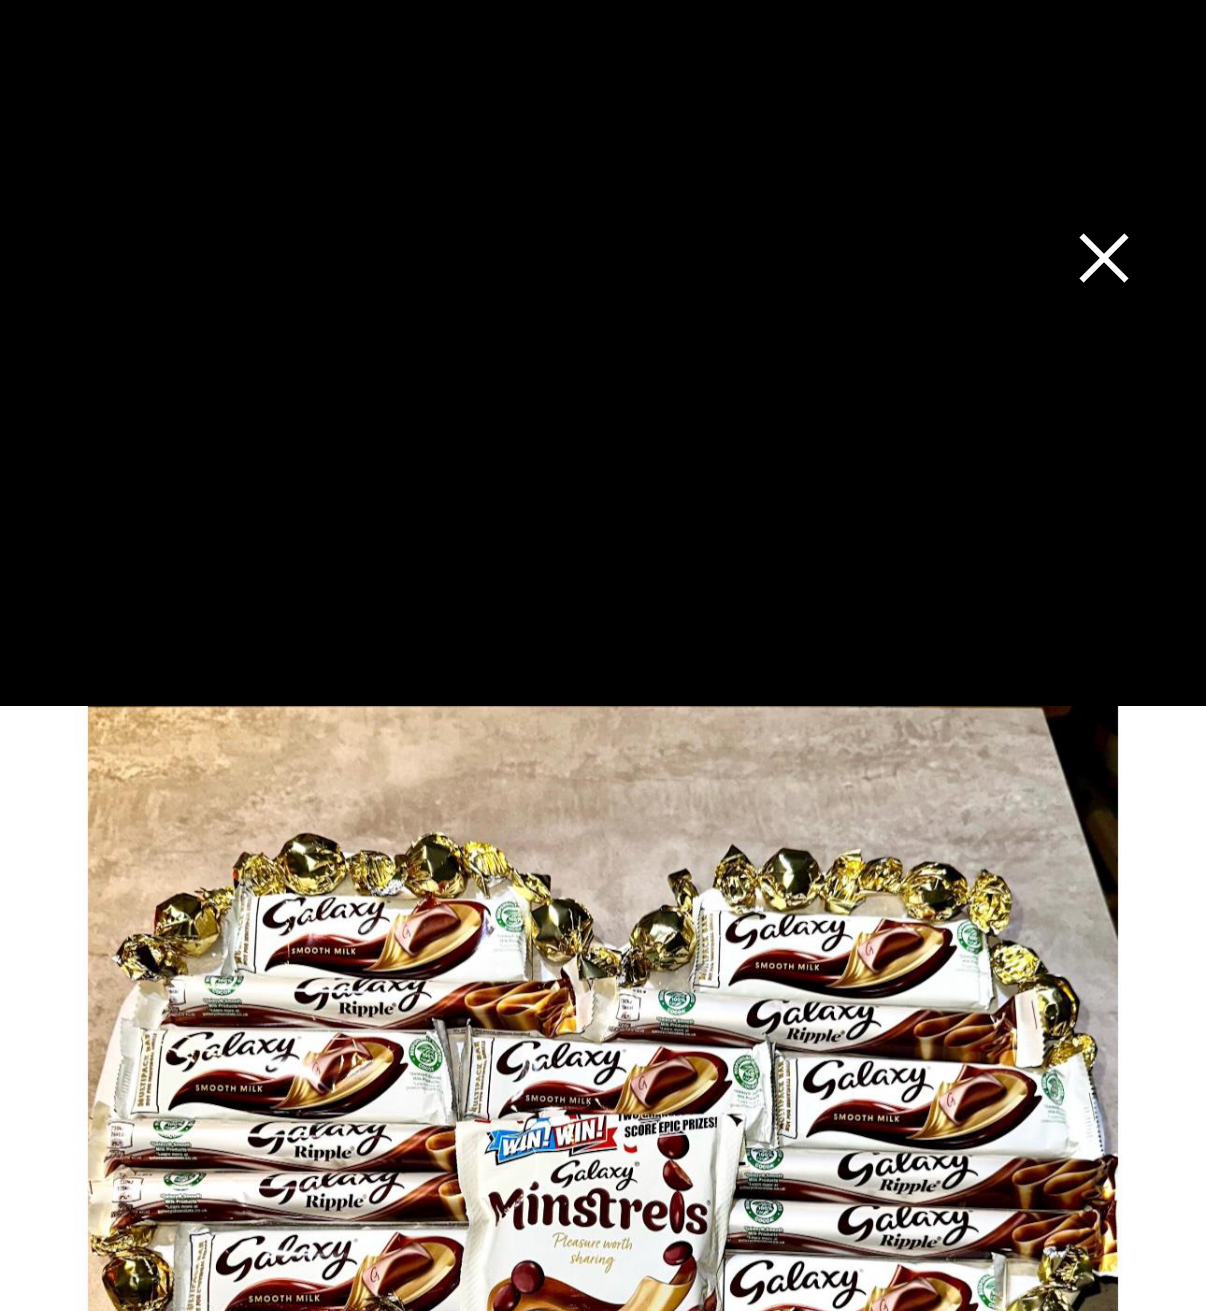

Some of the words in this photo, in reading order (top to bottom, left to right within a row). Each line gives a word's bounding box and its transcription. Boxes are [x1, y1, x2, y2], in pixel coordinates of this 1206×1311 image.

[262, 897, 390, 936] Galaxy
[725, 911, 854, 952] Galaxy
[291, 946, 331, 956] SMOOTH
[333, 947, 357, 956] MILK
[754, 961, 795, 972] SMOOTH
[797, 962, 820, 972] MILK
[339, 1002, 394, 1018] Ripple
[746, 999, 882, 1041] Galaxy
[786, 1027, 841, 1045] Ripple
[165, 1031, 300, 1073] Galaxy
[496, 1040, 627, 1085] Galaxy
[195, 1084, 237, 1093] SMOOTH
[239, 1085, 263, 1094] MILK
[803, 1060, 935, 1103] Galaxy
[525, 1094, 566, 1104] SMOOTH
[568, 1096, 592, 1106] MILK
[624, 1123, 657, 1138] SCORE
[658, 1119, 681, 1133] EPIC
[682, 1116, 718, 1131] PRIZES!
[833, 1112, 875, 1123] SMOOTH
[877, 1114, 900, 1123] MILK
[504, 1126, 550, 1157] WIN!
[555, 1116, 605, 1146] WIN!
[294, 1145, 351, 1162] Ripple
[550, 1159, 640, 1191] Galaxy
[837, 1152, 979, 1191] Galaxy
[880, 1178, 937, 1195] Ripple
[305, 1194, 364, 1211] Ripple
[489, 1181, 708, 1236] Minstrels
[837, 1205, 980, 1245] Galaxy
[552, 1233, 600, 1250] Pleasure
[602, 1237, 633, 1250] worth
[880, 1234, 937, 1251] Ripple
[216, 1233, 358, 1282] Galaxy
[570, 1254, 615, 1274] sharing
[729, 1259, 867, 1310] Galaxy
[248, 1294, 292, 1304] SMOOTH
[295, 1294, 321, 1303] MILK
